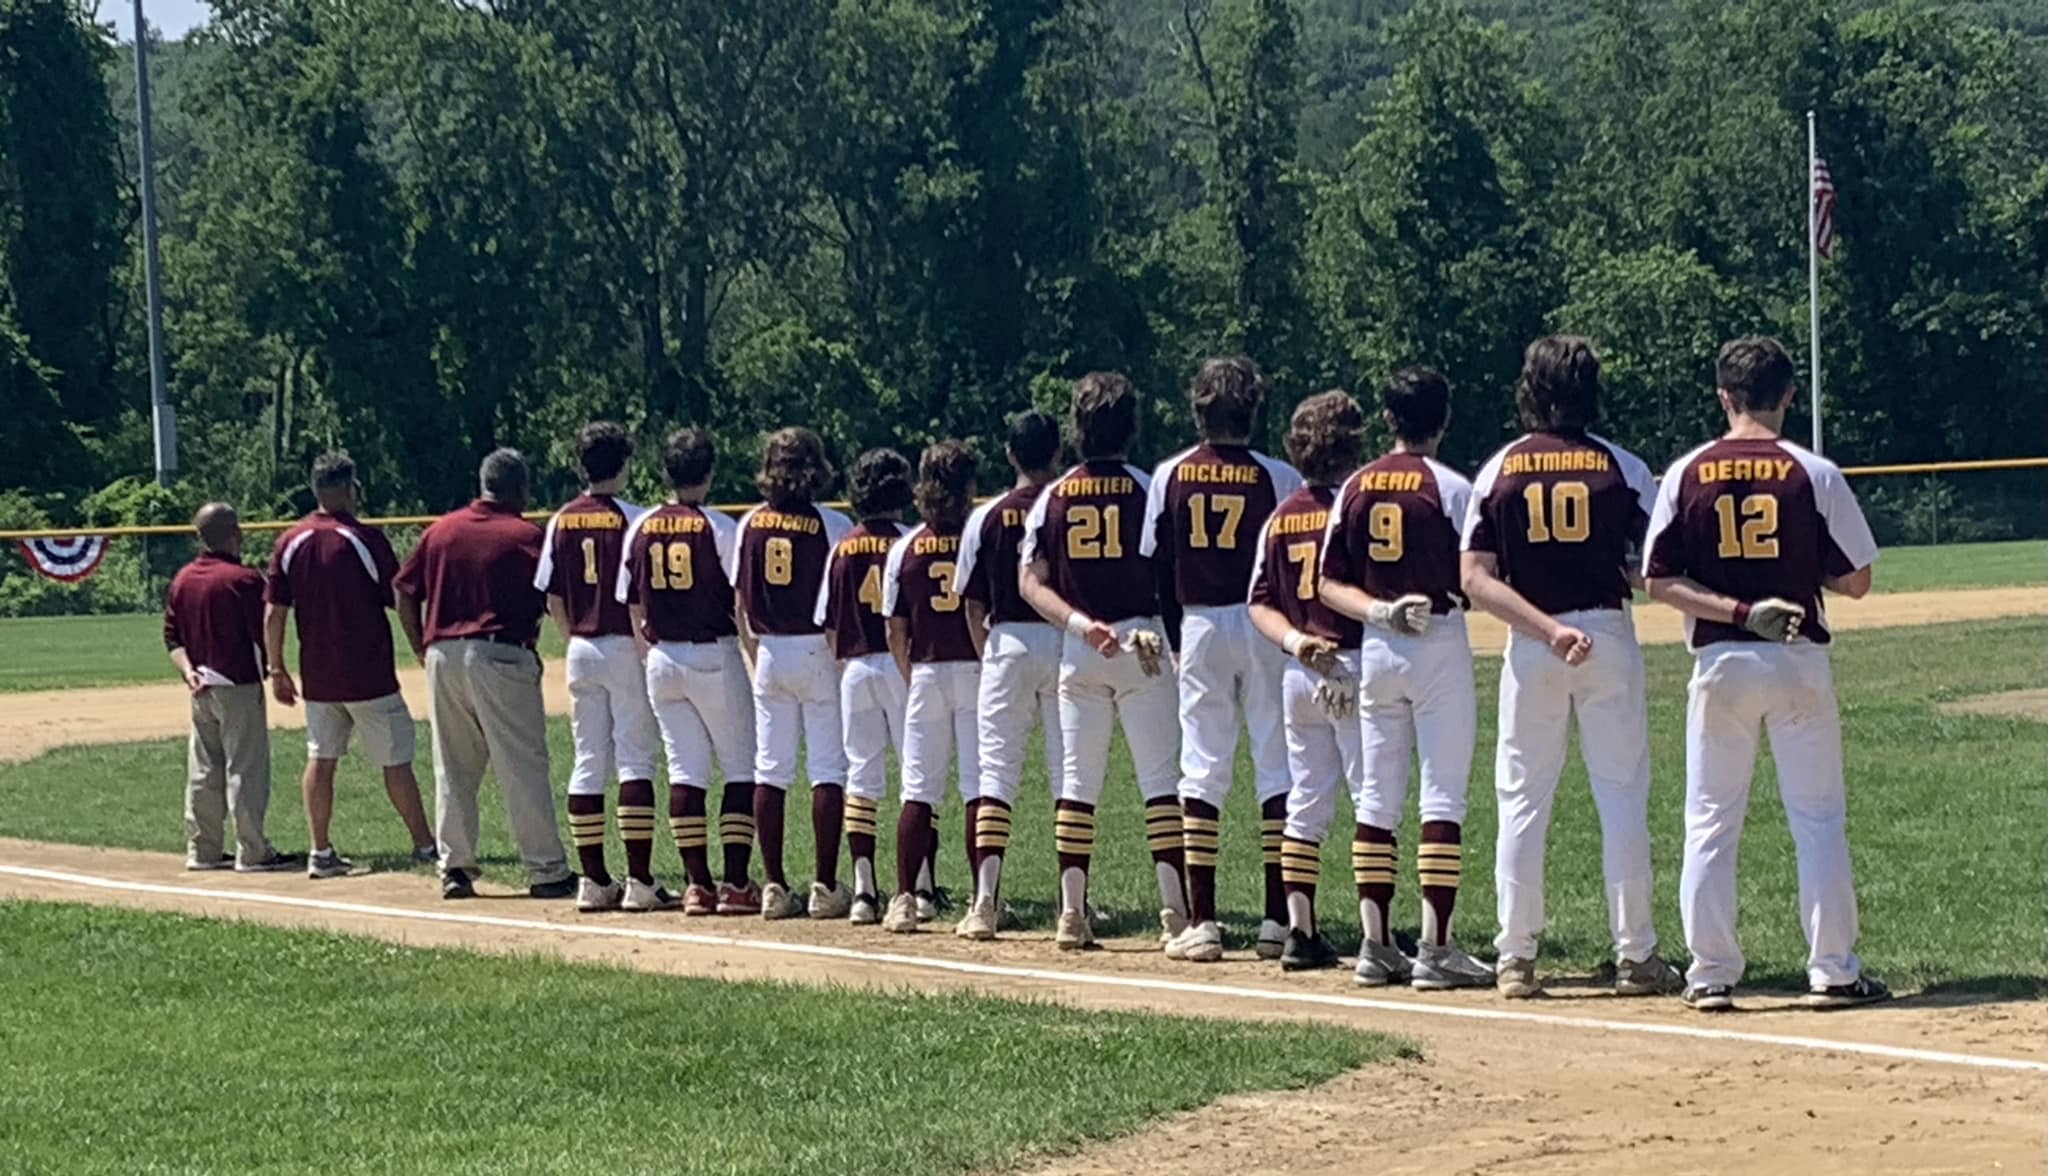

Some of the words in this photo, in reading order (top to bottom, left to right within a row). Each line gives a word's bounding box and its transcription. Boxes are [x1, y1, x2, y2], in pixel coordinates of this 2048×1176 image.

[1058, 475, 1134, 497] FORTIER
[1177, 463, 1258, 485] MCLANE
[1360, 471, 1423, 492] KERN
[1503, 450, 1609, 475] SALTMARSH
[642, 515, 705, 534] SELLERS
[1066, 504, 1123, 559] 21
[1187, 493, 1245, 549] 17
[1268, 509, 1332, 537] ALMEID
[1368, 502, 1402, 562] 9
[1524, 481, 1590, 543] 10
[1715, 494, 1779, 559] 12
[582, 537, 598, 584] 1
[649, 542, 694, 590] 19
[765, 537, 793, 586] 8
[1287, 541, 1317, 599] 7
[858, 564, 883, 613] 4
[929, 561, 960, 611] 3
